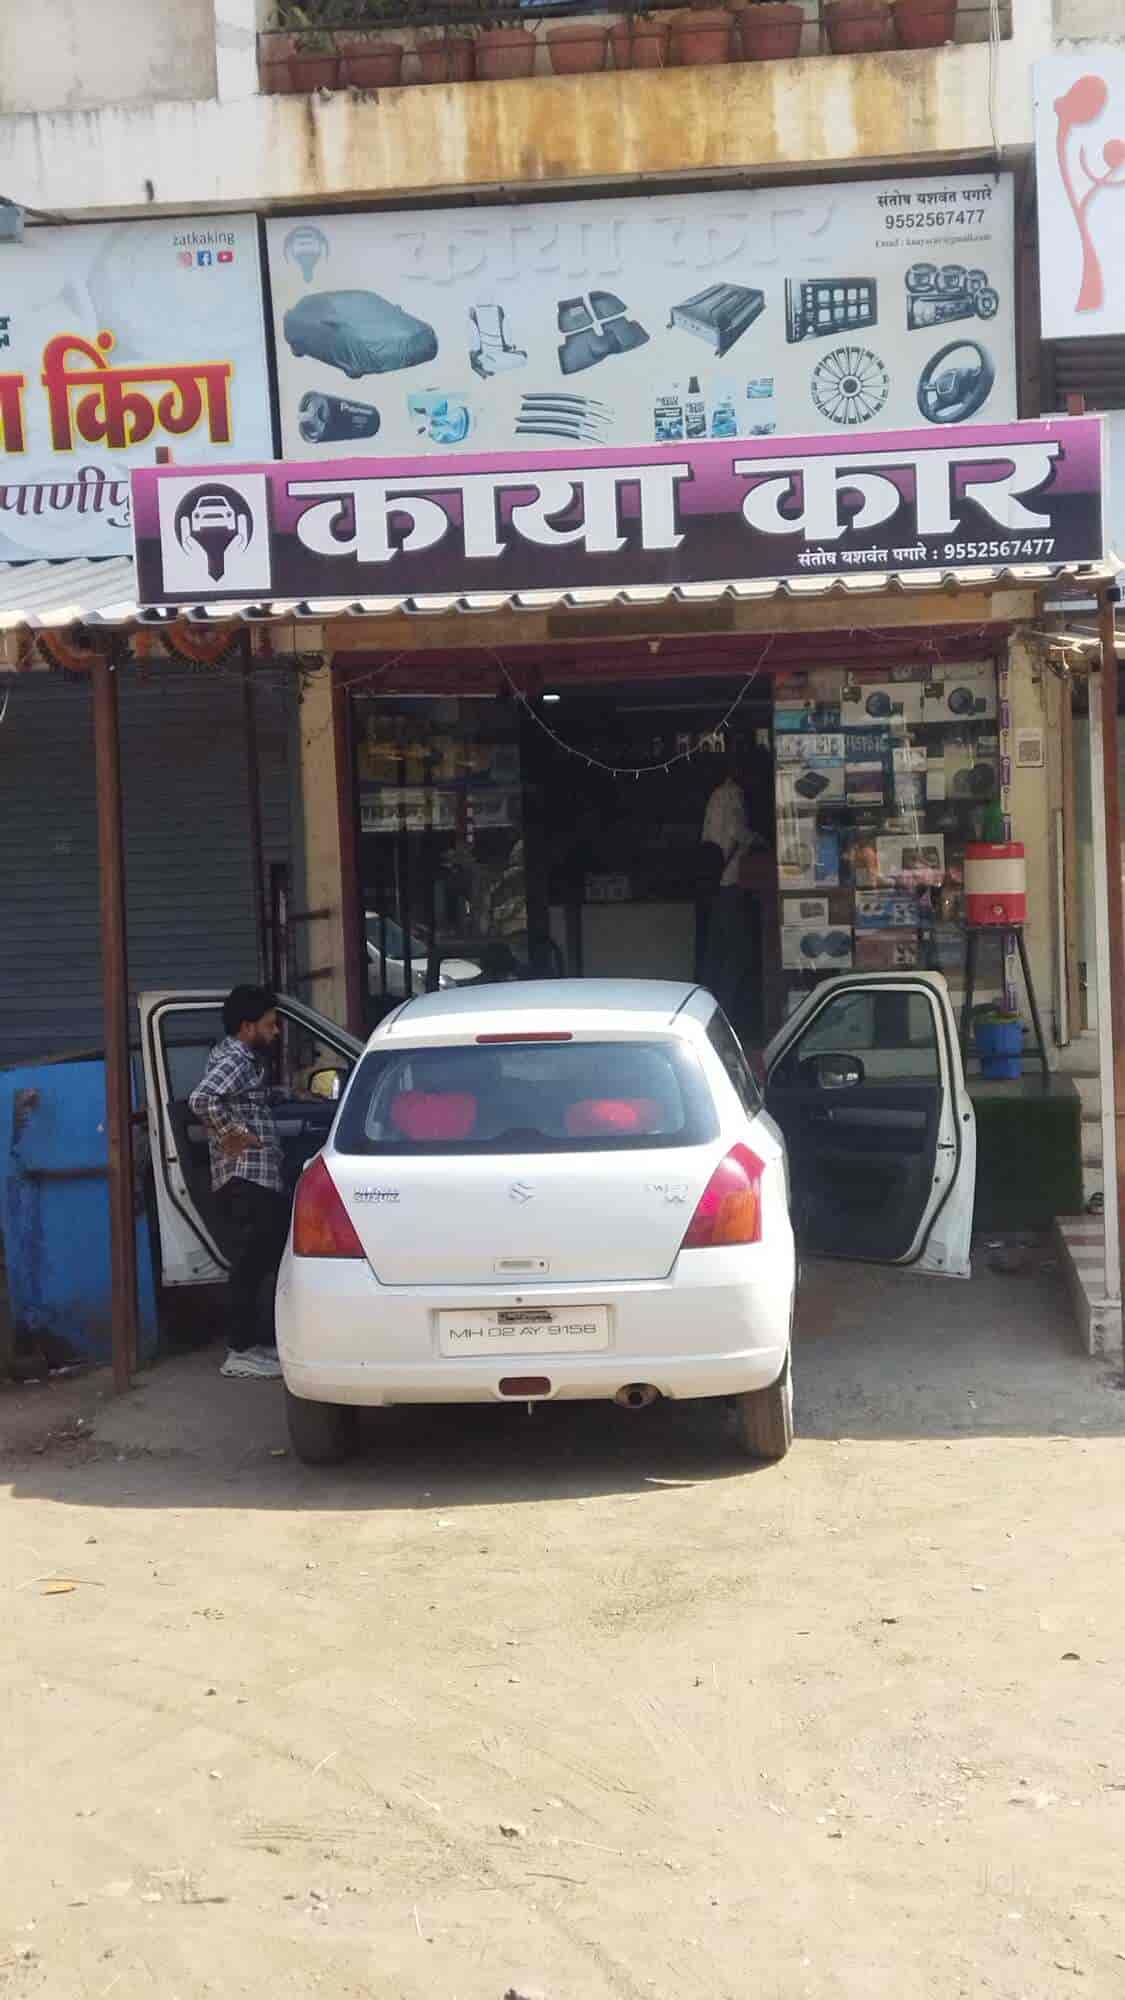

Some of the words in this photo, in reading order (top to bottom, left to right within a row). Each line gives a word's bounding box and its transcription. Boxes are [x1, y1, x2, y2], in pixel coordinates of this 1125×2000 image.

[877, 189, 912, 208] संतोष
[916, 186, 958, 205] यशवंत
[962, 183, 992, 202] पगारे
[885, 209, 985, 229] 9552567477
[173, 230, 235, 246] zatkaking
[41, 331, 231, 450] किंग
[287, 463, 691, 562] काया
[733, 441, 1064, 541] कार
[798, 547, 836, 567] संतोष
[841, 545, 888, 563] यशवंत
[893, 542, 927, 561] पगारे
[944, 538, 1056, 560] 9552567477
[450, 1328, 483, 1340] MH
[520, 1326, 541, 1337] AY
